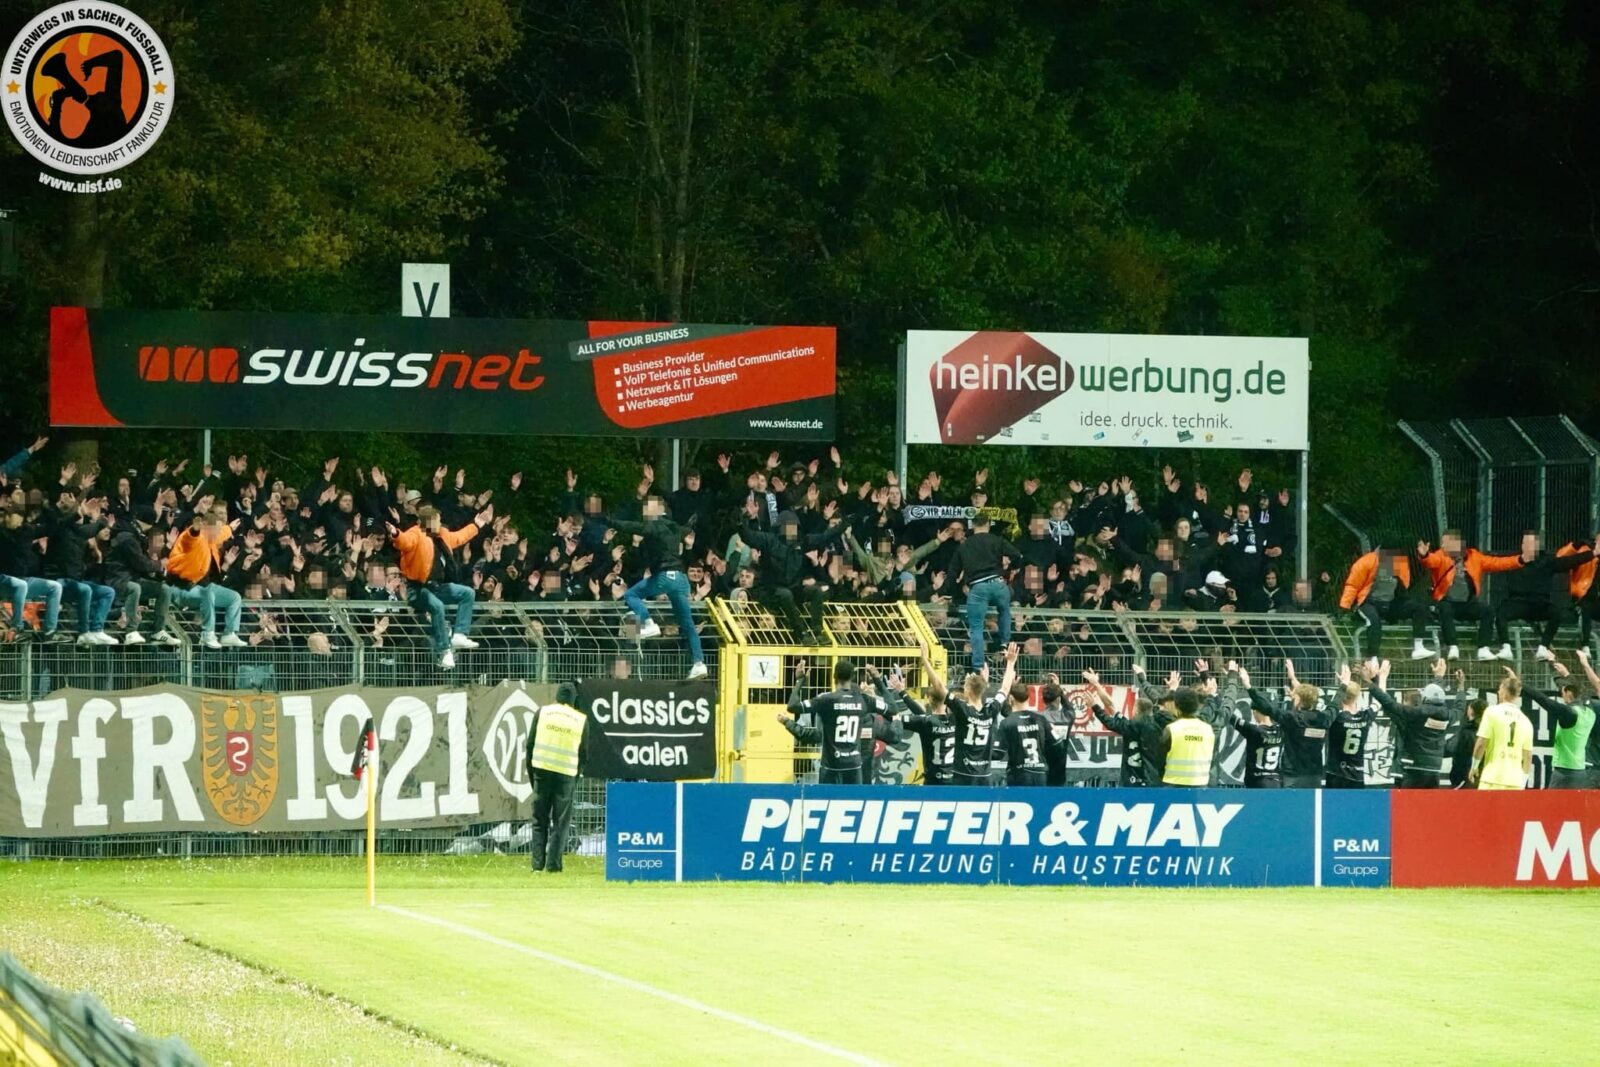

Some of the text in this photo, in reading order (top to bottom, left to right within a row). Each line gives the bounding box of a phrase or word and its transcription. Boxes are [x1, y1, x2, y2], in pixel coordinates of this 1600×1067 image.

[412, 281, 440, 317] V
[577, 327, 690, 356] ALL FOR YOUR BUSINESS
[242, 338, 545, 391] swissnet
[623, 351, 705, 373] Business Provider
[624, 345, 815, 386] VoIP Telefonie & Unified Communications
[626, 372, 738, 400] Netzwerk & IT Lösungen
[936, 355, 1287, 403] heinkel werbung.de
[627, 391, 694, 412] Werbeagentur
[750, 419, 823, 430] www.swissnet.de
[1081, 411, 1233, 429] idee. druck. technik.
[758, 661, 770, 678] V
[592, 691, 710, 726] classics
[835, 715, 859, 743] 20
[963, 724, 990, 746] 15
[1343, 729, 1362, 755] 6
[1507, 721, 1516, 747] 1
[0, 692, 205, 828] VfR
[282, 691, 480, 822] 1921
[622, 742, 688, 766] aalen
[932, 737, 955, 765] 12
[1022, 738, 1040, 764] 3
[1256, 746, 1281, 770] 19
[741, 798, 1245, 847] PFEIFFER & MAY
[618, 832, 664, 846] P&M
[1333, 839, 1379, 853] P&M
[1516, 821, 1600, 881] M
[618, 856, 664, 871] Gruppe
[741, 848, 1235, 876] BÄDER HEIZUNG HAUSTECHNIK
[1333, 863, 1379, 878] Gruppe
